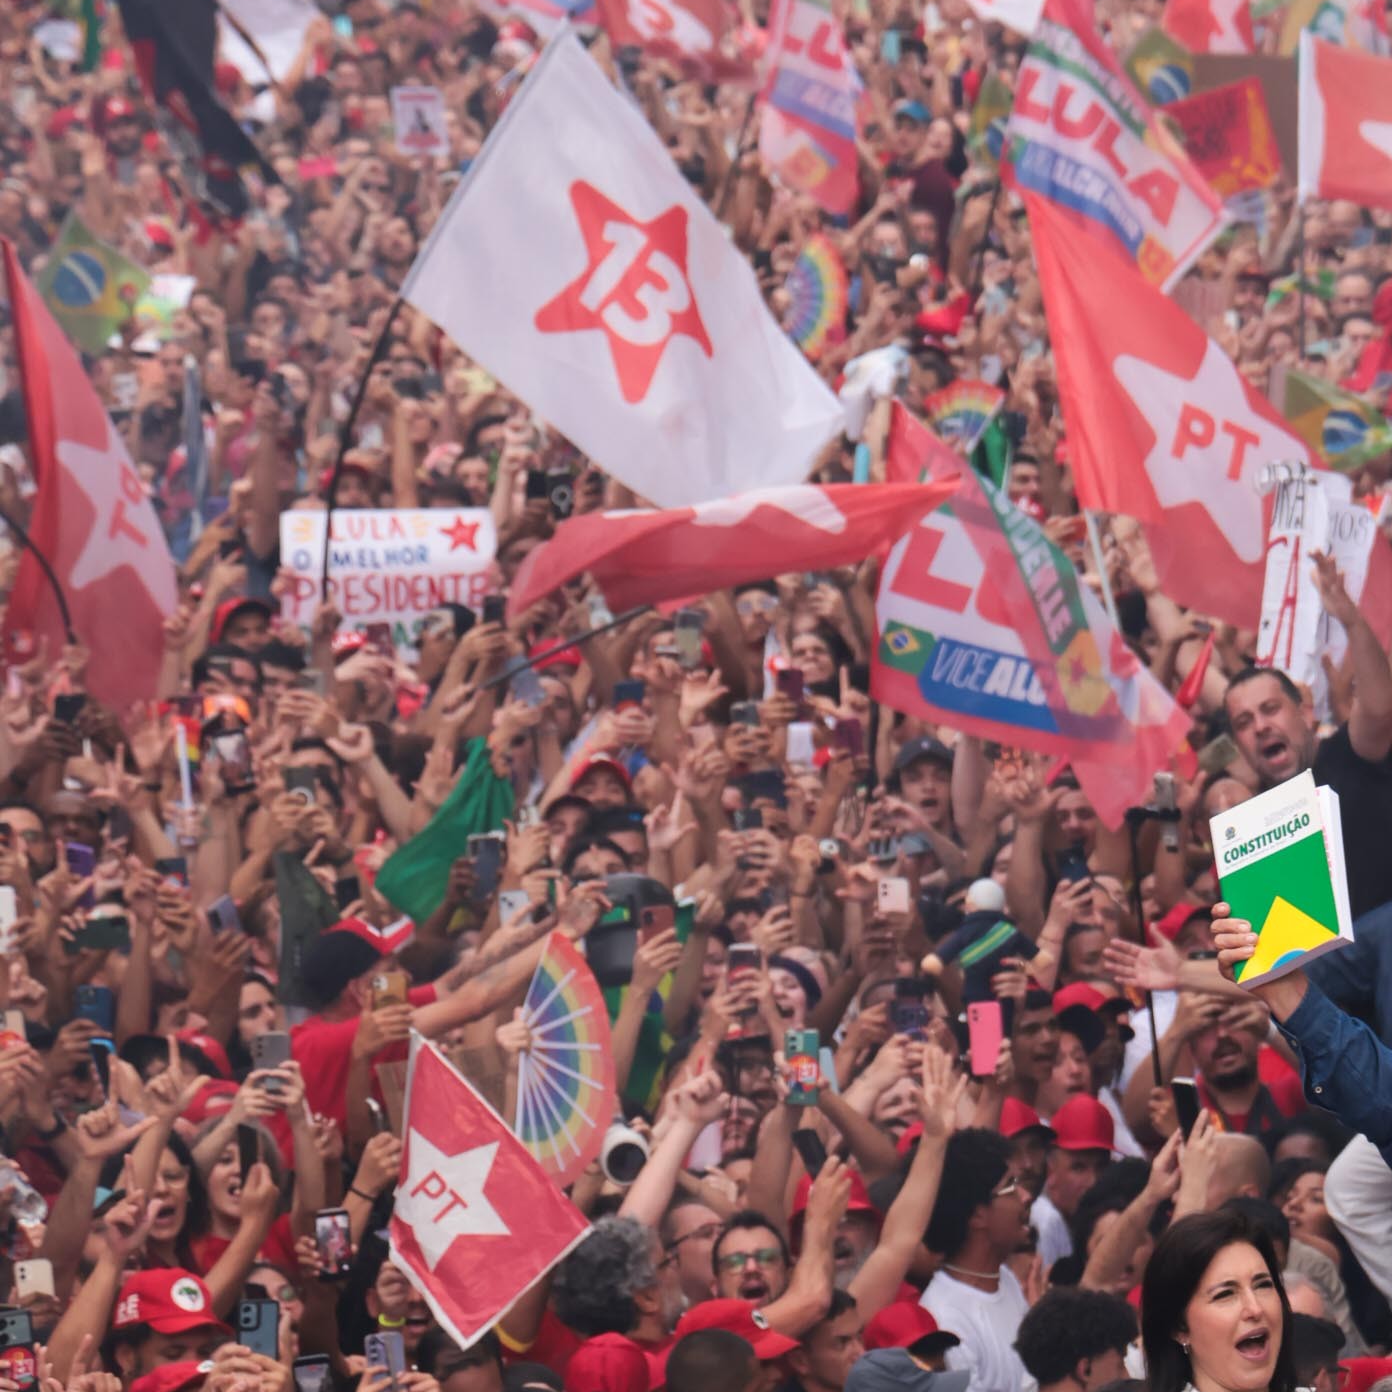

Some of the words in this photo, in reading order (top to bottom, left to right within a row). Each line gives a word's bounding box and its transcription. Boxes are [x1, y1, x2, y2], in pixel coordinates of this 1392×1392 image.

[1012, 67, 1181, 229] LULA
[579, 220, 692, 347] 13
[1170, 401, 1261, 482] PT
[330, 517, 405, 543] LULA
[293, 549, 311, 570] O
[332, 545, 430, 570] MELHOR
[931, 642, 992, 693] VICE
[1223, 813, 1311, 865] CONSTITUIÇÃO
[410, 1170, 469, 1223] PT
